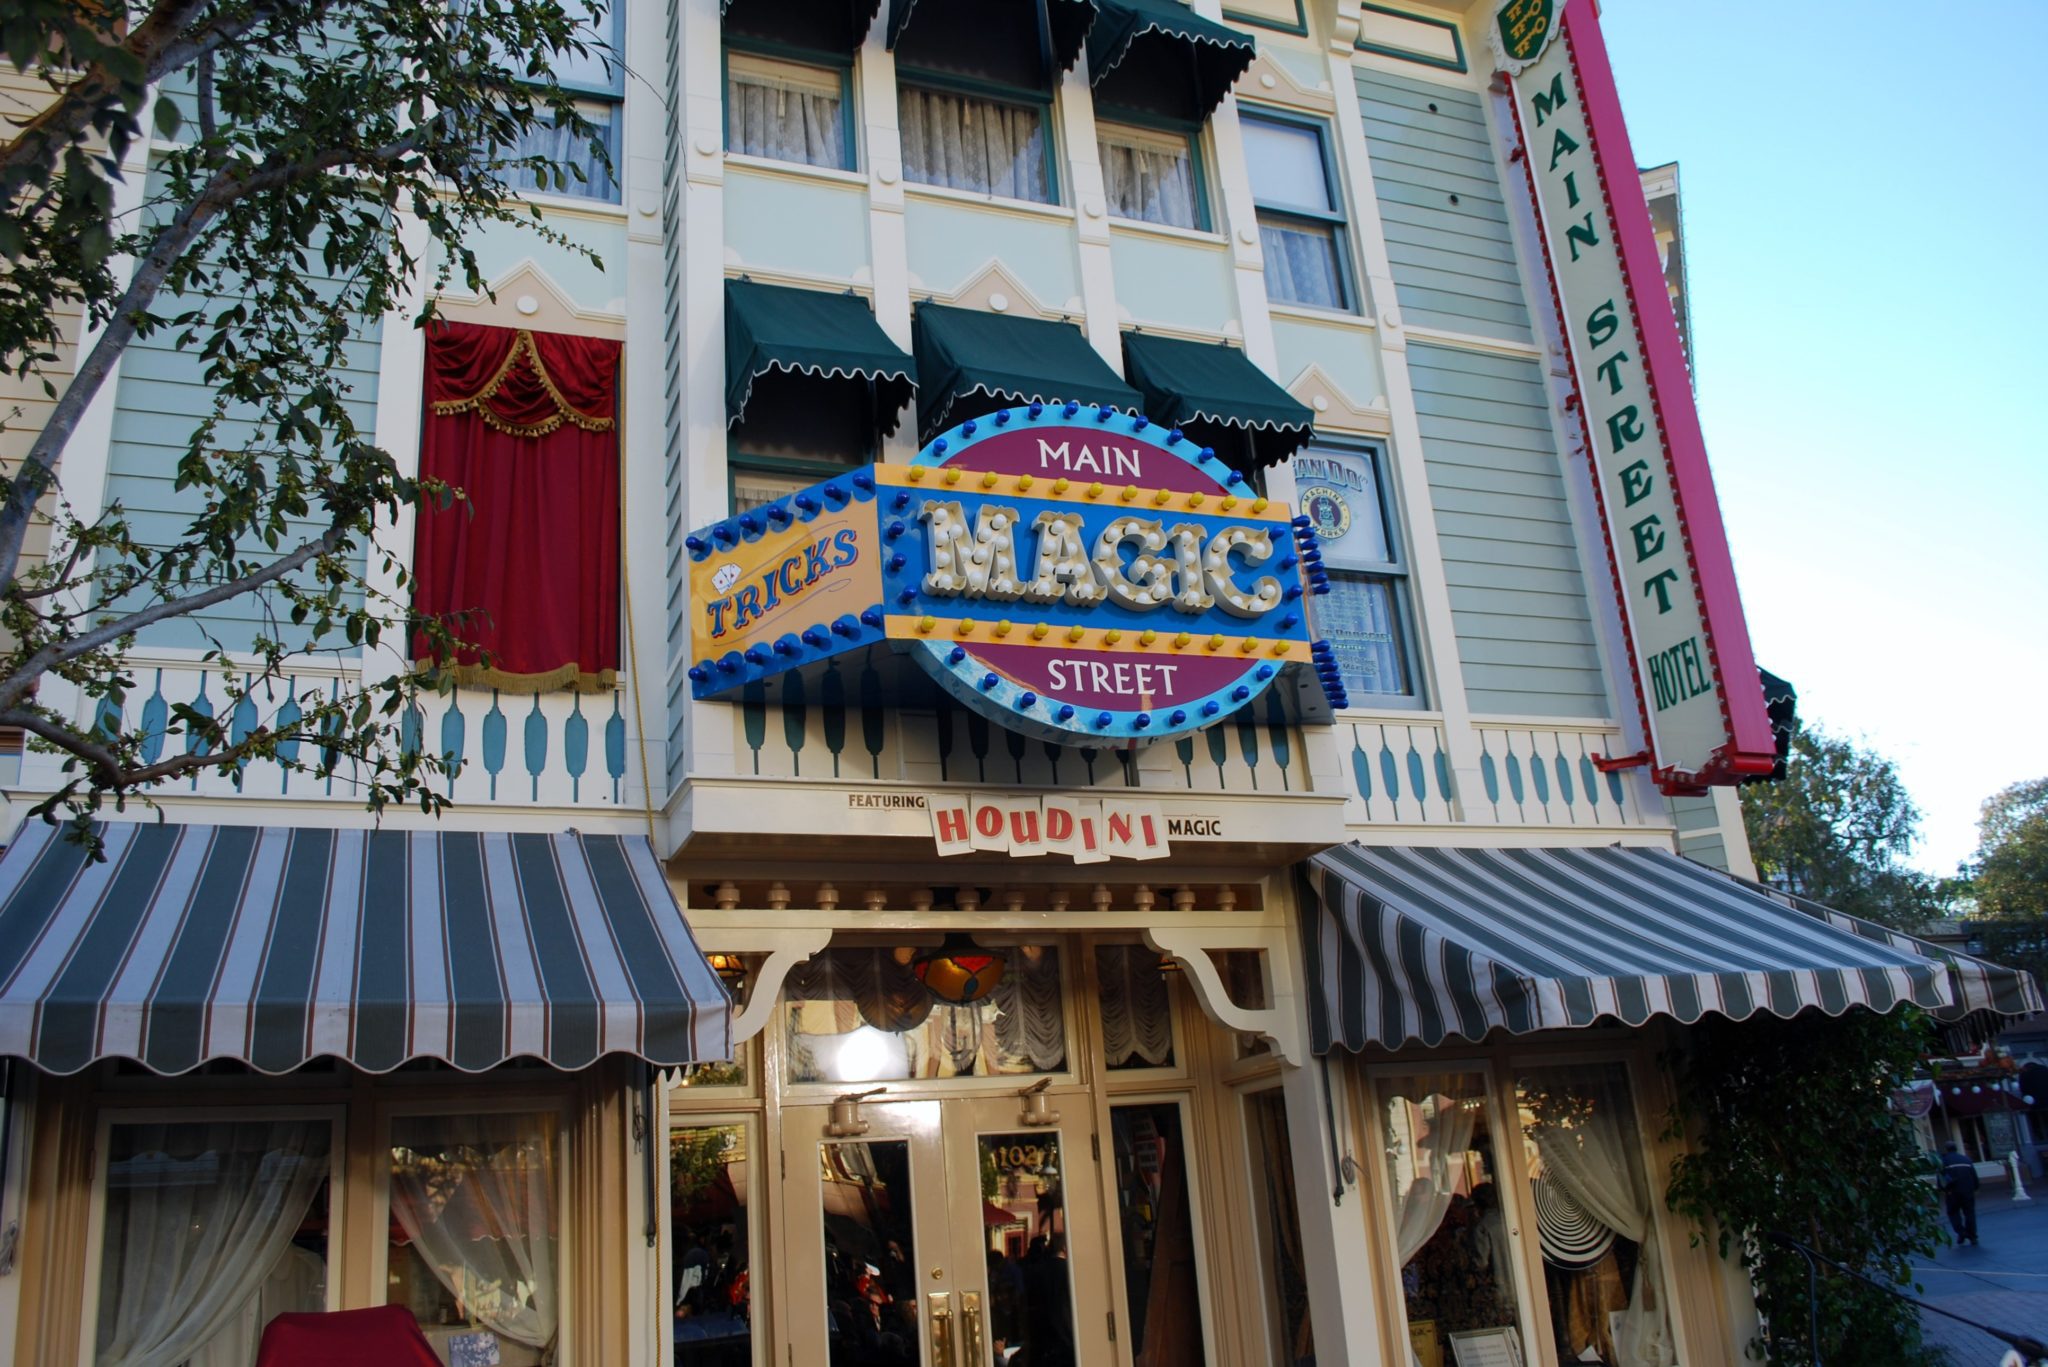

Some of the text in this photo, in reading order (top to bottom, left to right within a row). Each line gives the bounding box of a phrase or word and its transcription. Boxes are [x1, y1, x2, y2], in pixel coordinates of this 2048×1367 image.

[1533, 71, 1678, 615] MAIN STREET
[1037, 439, 1142, 478] MAIN
[1294, 458, 1327, 481] AN
[1303, 488, 1345, 507] MACHINE
[706, 527, 860, 639] TRICKS
[917, 500, 1284, 619] MAGIC
[1048, 659, 1177, 695] STREET
[1647, 636, 1711, 712] HOTEL
[848, 793, 1222, 852] FEATURING HOUDINI MAGIC
